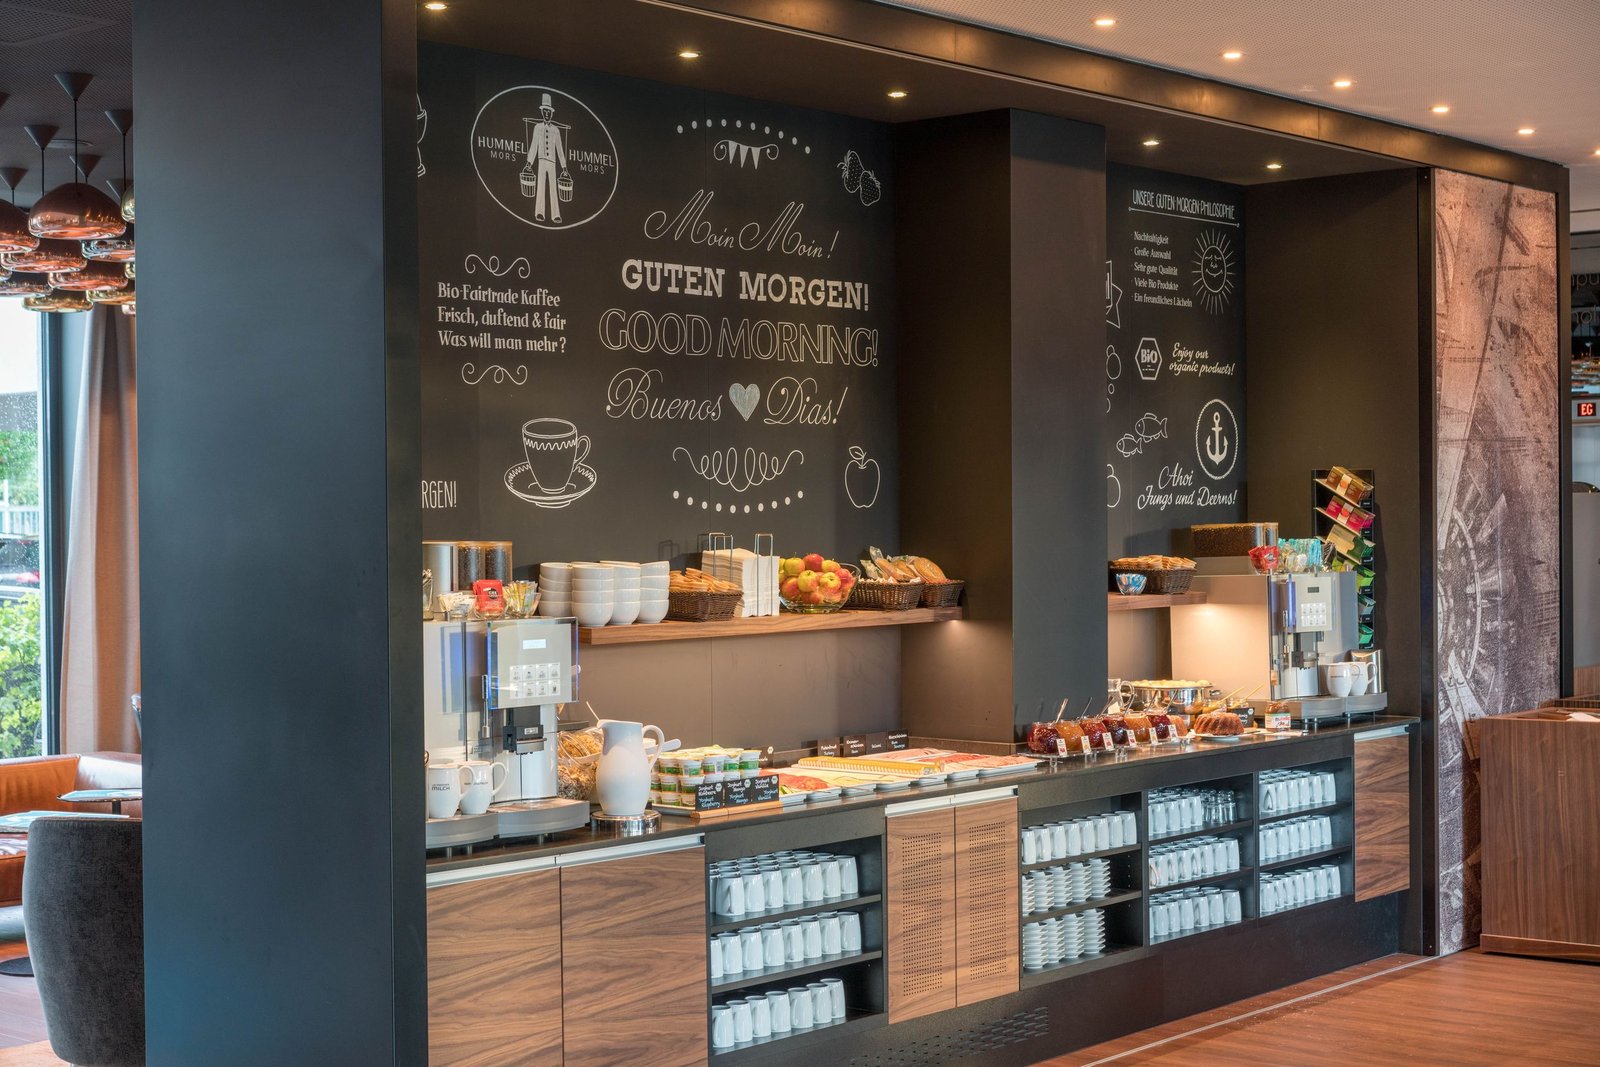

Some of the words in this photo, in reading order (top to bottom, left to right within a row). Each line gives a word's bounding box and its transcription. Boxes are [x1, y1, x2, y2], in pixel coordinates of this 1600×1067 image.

[477, 135, 527, 155] HUMMEL
[490, 150, 517, 162] MORS
[569, 149, 615, 167] HUMMEL
[580, 163, 605, 175] MORS
[1132, 189, 1154, 208] UNSERE
[1155, 193, 1175, 211] GUTEN
[1176, 196, 1200, 214] MORGEN
[1200, 200, 1235, 220] PHILOSOPHIE
[644, 189, 735, 249] Moin
[437, 281, 519, 305] Bio-Fairtrade
[520, 288, 561, 307] Kaffee
[621, 258, 726, 298] GUTEN
[739, 271, 869, 311] MORGEN!
[1157, 280, 1179, 291] Produkte
[437, 306, 479, 327] Frisch,
[481, 308, 529, 328] duftend
[532, 312, 542, 328] &
[544, 312, 567, 331] fair
[437, 330, 467, 347] Was
[468, 332, 492, 349] will
[494, 337, 523, 350] man
[598, 308, 712, 356] GOOD
[716, 317, 879, 367] MORNING!
[1172, 342, 1194, 363] Enjoy
[1195, 350, 1209, 359] our
[1168, 361, 1199, 376] organic
[1198, 361, 1236, 377] products!
[606, 367, 723, 421] Buenos
[1581, 403, 1593, 416] EG
[1158, 462, 1194, 490] Ahoi
[421, 480, 457, 509] RGEN!
[1137, 485, 1173, 511] Jungs
[1174, 490, 1196, 506] und
[1196, 486, 1238, 507] Deerns!
